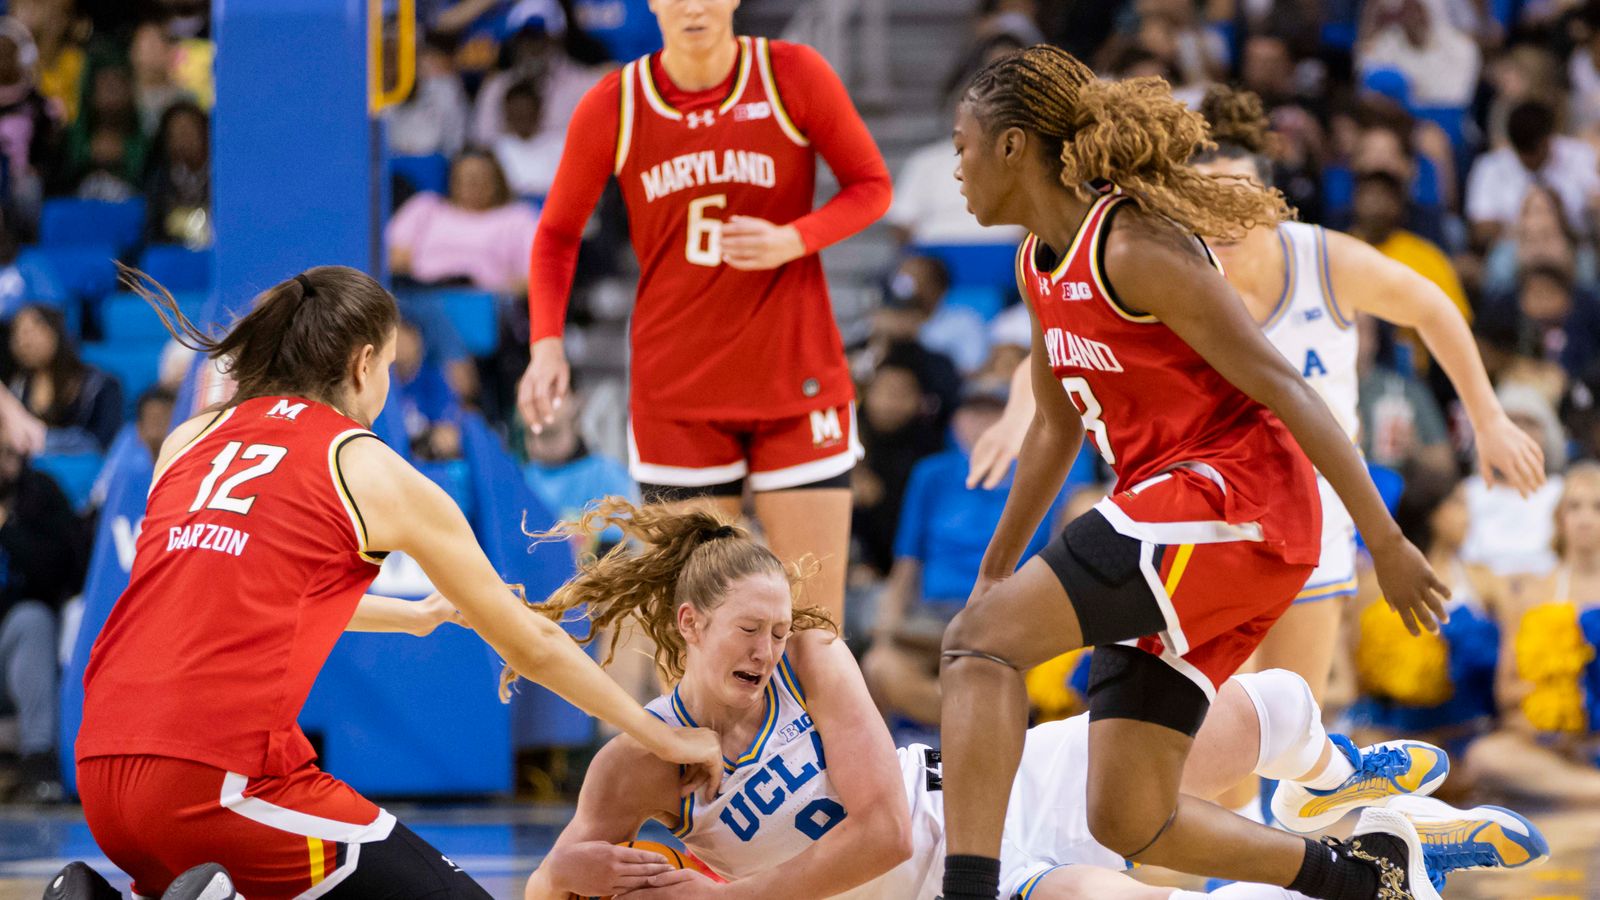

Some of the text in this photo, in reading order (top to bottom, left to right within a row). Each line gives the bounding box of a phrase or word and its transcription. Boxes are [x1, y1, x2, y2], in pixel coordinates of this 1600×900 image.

[640, 149, 776, 203] MARYLAND
[685, 194, 728, 268] 6
[187, 440, 289, 517] 12
[165, 523, 250, 557] GARZON
